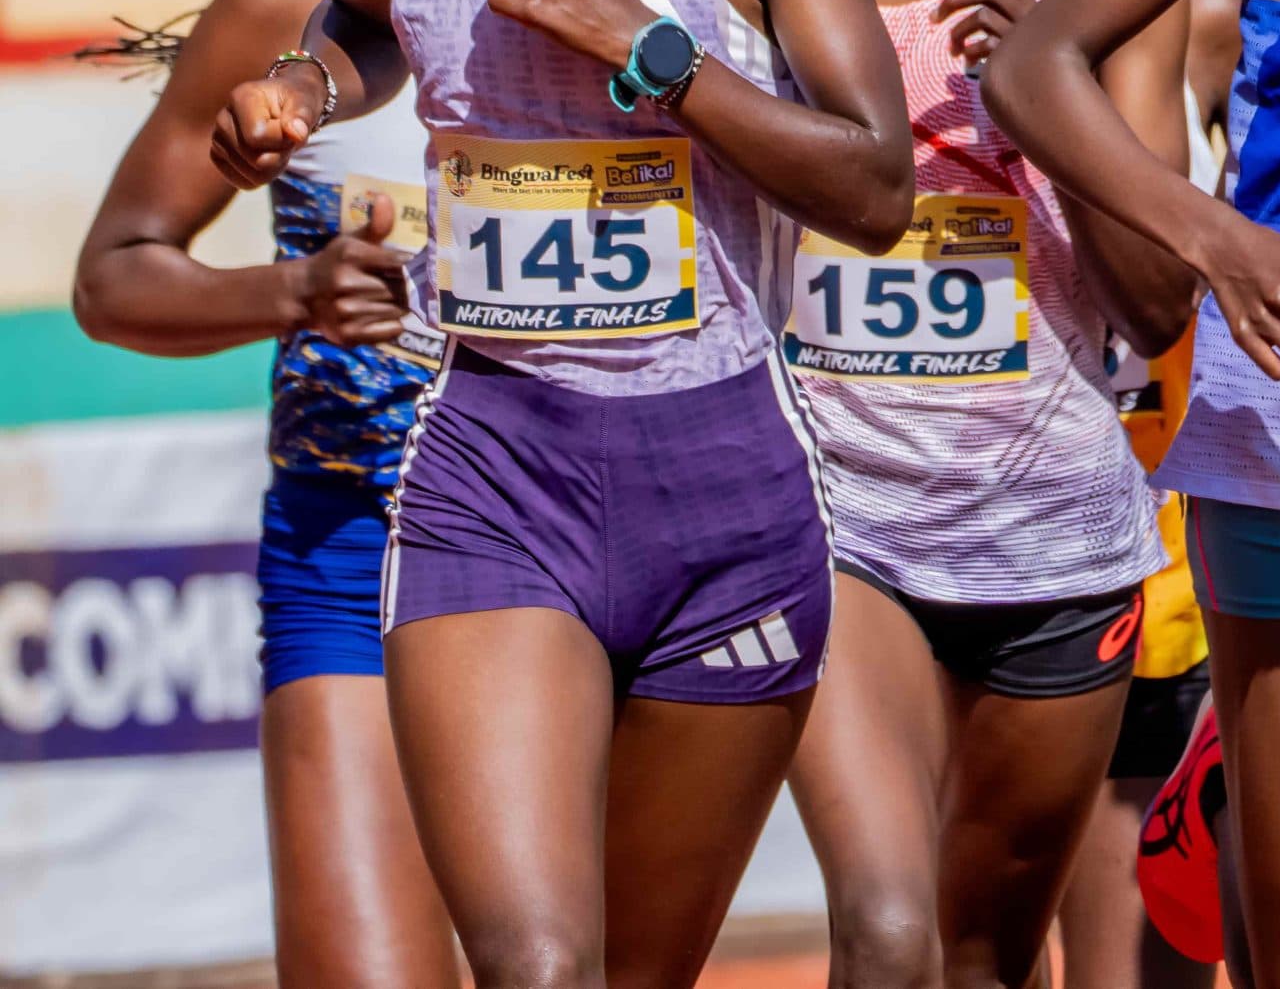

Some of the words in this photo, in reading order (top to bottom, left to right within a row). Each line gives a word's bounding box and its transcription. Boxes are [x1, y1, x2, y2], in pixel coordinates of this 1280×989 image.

[481, 163, 594, 186] BingwaFest
[606, 161, 673, 186] Betika!
[470, 217, 651, 292] 145
[455, 304, 563, 328] NATIONAL
[573, 300, 673, 326] FINALS
[808, 264, 986, 339] 159
[797, 347, 900, 372] NATIONAL
[910, 350, 1008, 374] FINALS
